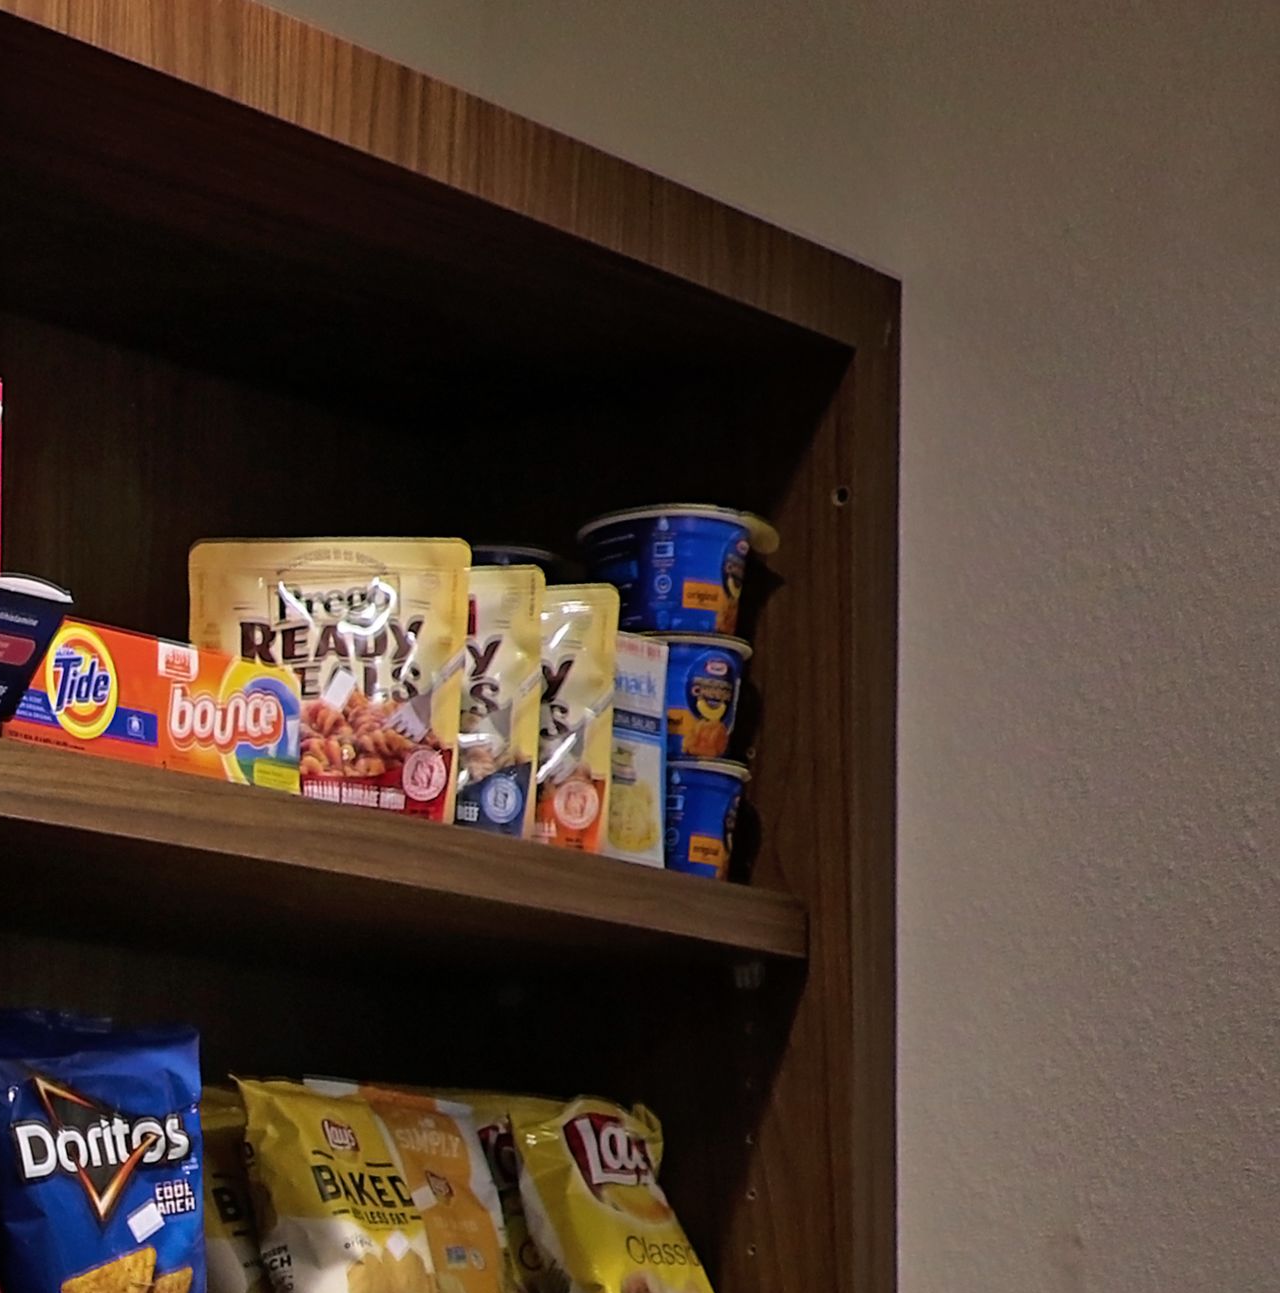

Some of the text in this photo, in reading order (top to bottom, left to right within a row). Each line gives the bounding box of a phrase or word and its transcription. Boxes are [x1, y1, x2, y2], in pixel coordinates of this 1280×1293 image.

[240, 616, 425, 667] READY
[53, 655, 110, 714] Tide
[171, 683, 278, 743] bounce
[13, 1112, 192, 1181] Doritos
[154, 1183, 194, 1201] COOL
[311, 1164, 415, 1209] BAKED
[626, 1235, 702, 1267] Classic
